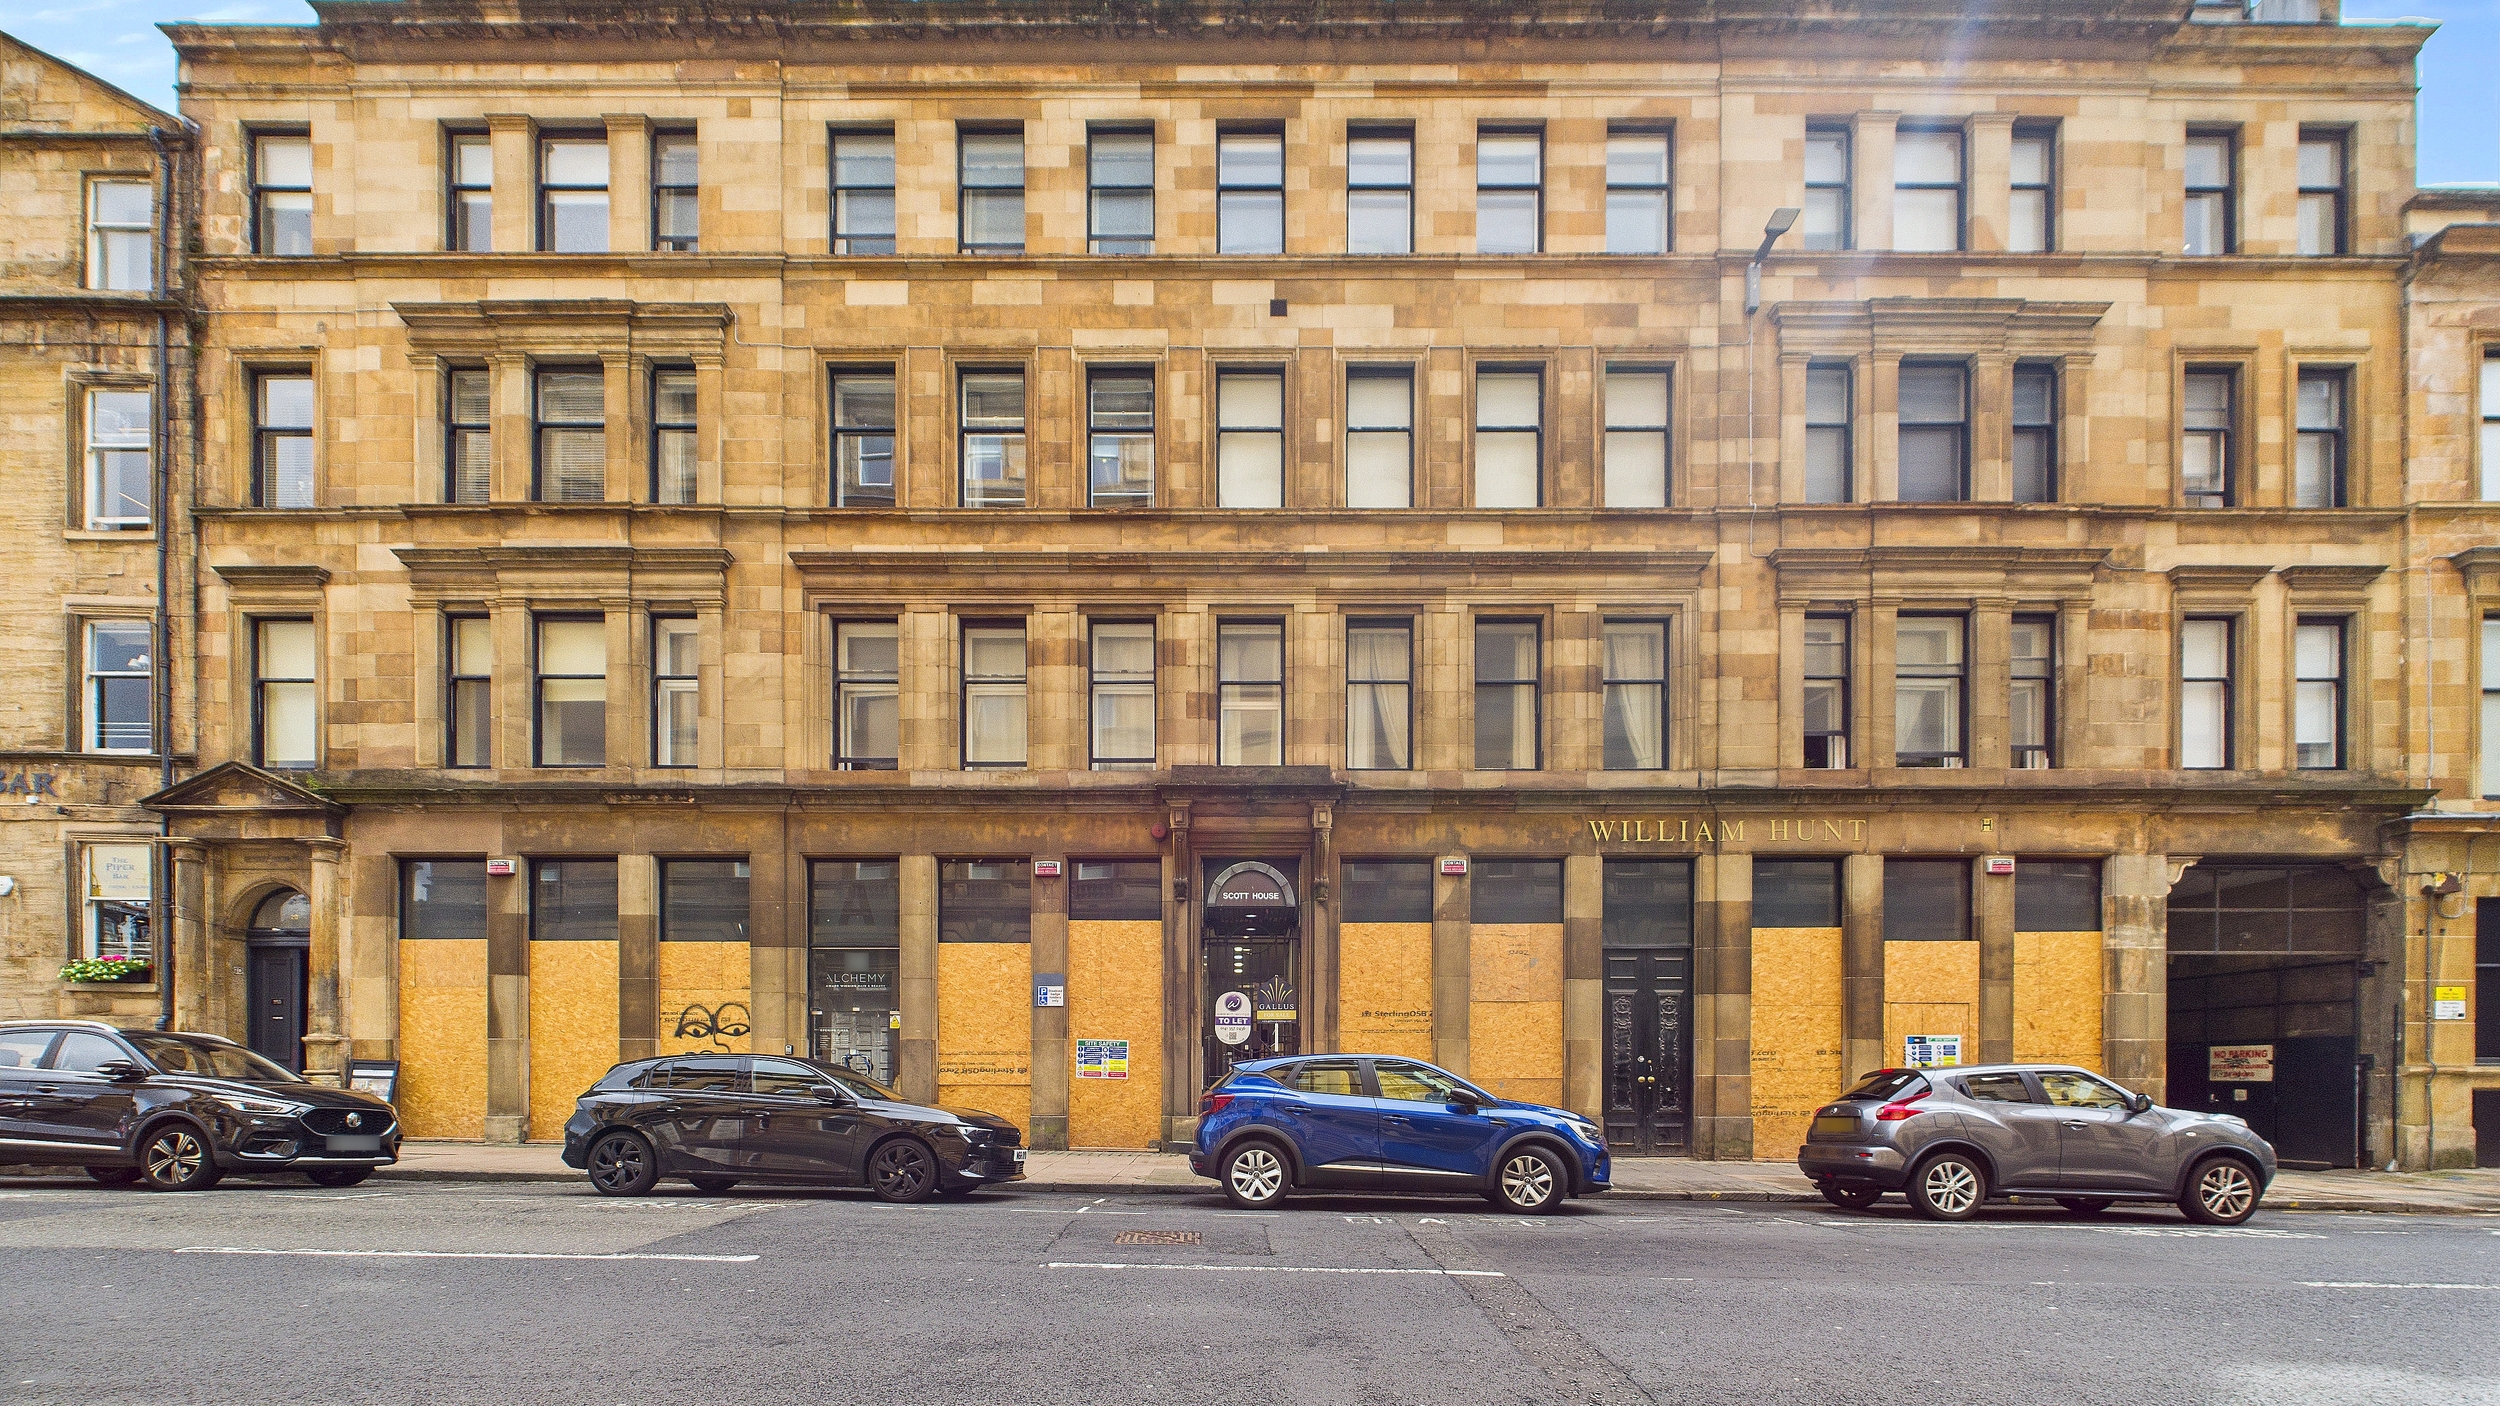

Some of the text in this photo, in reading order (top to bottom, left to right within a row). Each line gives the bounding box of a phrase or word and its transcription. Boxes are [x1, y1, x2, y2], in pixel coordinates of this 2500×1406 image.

[1588, 818, 1867, 843] WILLIAM HUNT
[106, 862, 135, 871] PIPER
[1222, 892, 1280, 900] SCOTT HOUSE
[825, 973, 886, 983] ALCHEMY
[1218, 1017, 1249, 1025] TO LET
[1098, 1040, 1121, 1048] SAFETY
[2213, 1049, 2268, 1059] NO PARKING
